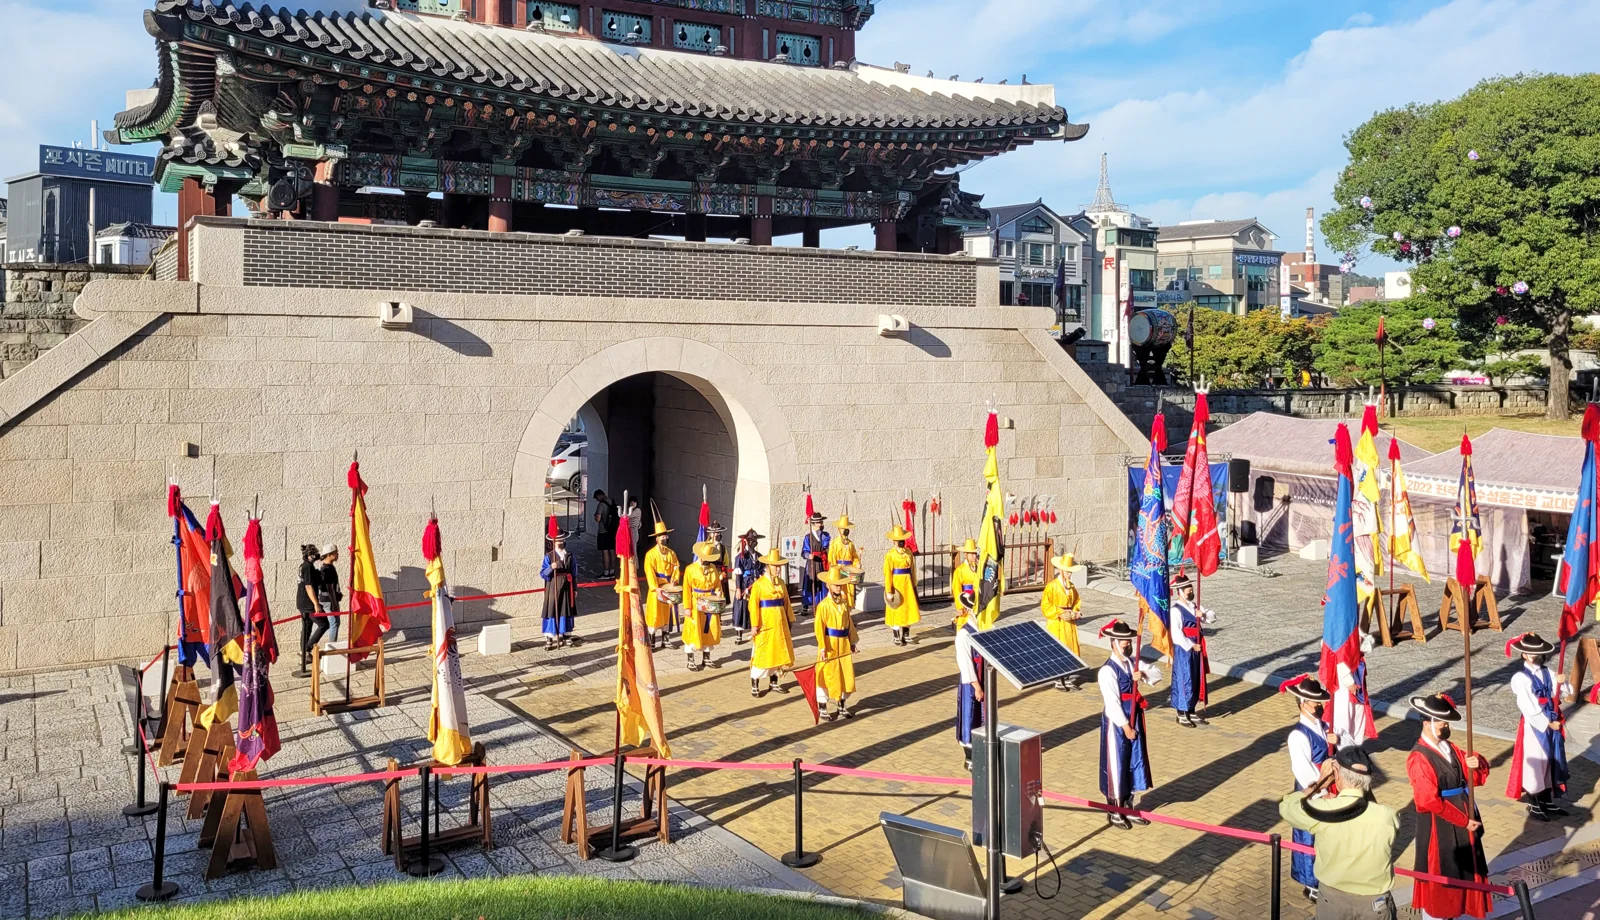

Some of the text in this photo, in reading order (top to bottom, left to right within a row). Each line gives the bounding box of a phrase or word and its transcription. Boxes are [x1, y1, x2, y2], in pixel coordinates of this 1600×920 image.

[45, 148, 152, 177] 포시즌 MOTEL
[1104, 257, 1115, 270] 民
[1407, 480, 1577, 511] 2022 진주 수성중군영 교대의
